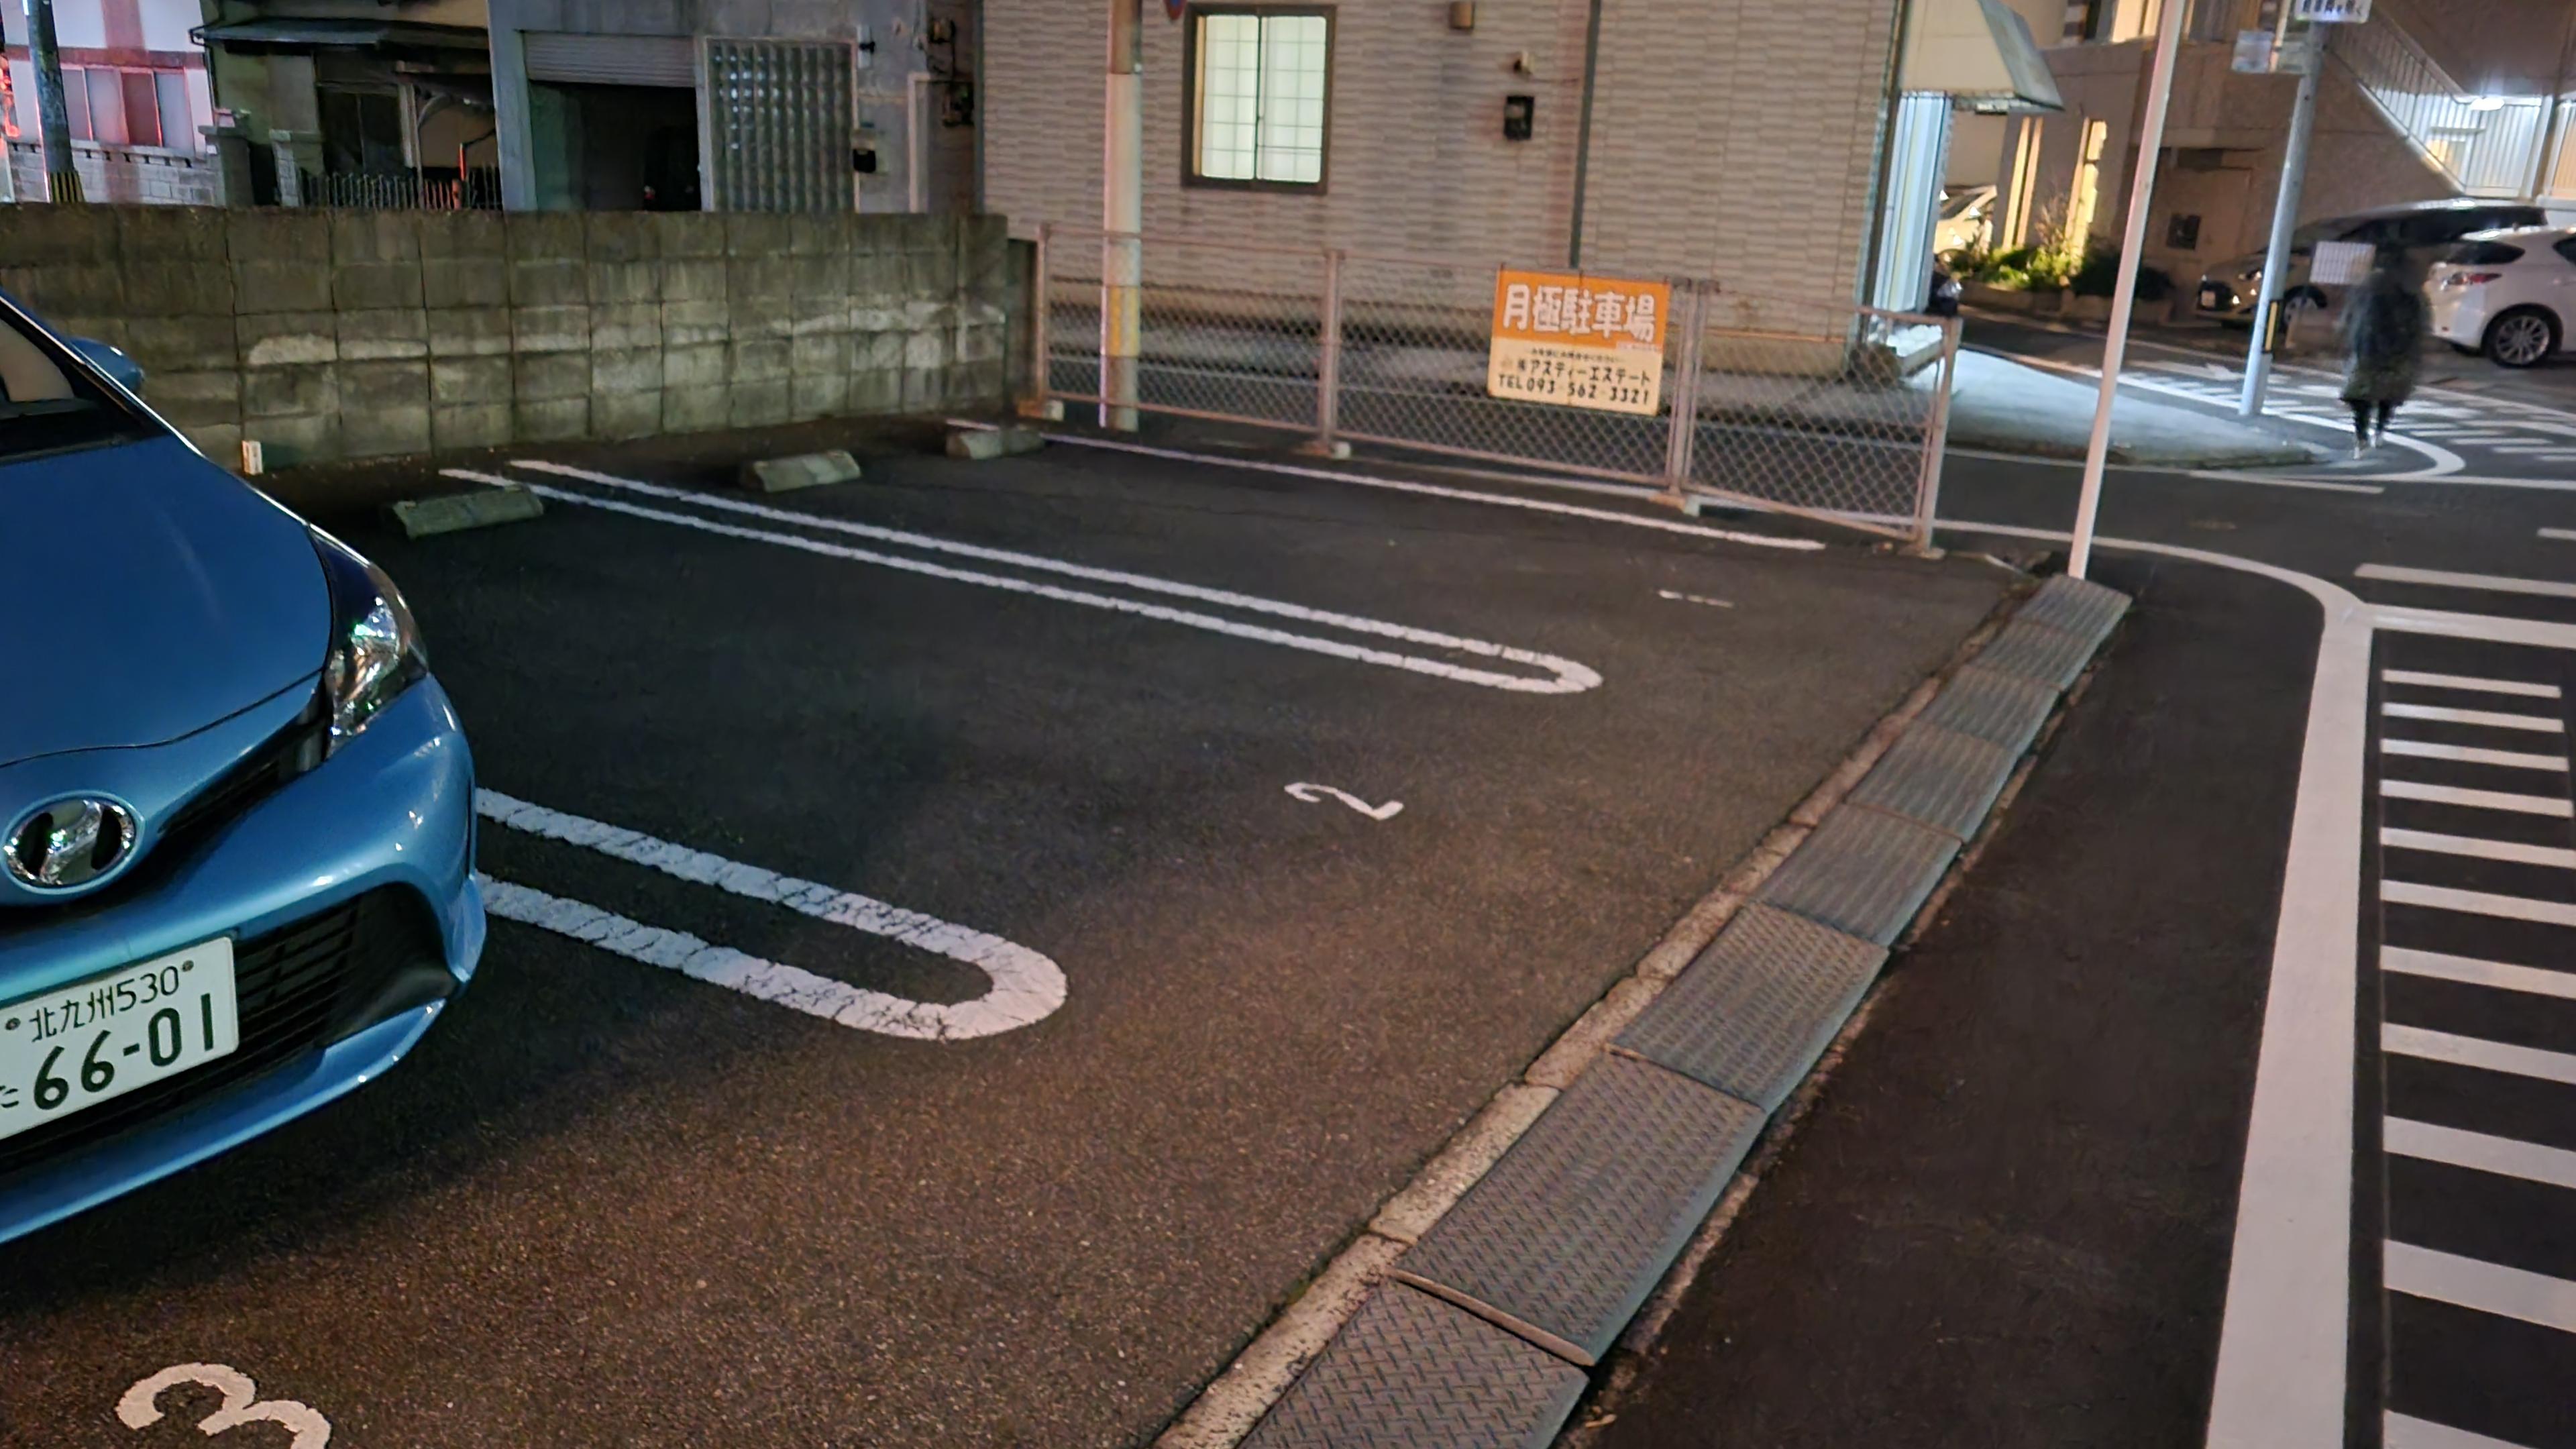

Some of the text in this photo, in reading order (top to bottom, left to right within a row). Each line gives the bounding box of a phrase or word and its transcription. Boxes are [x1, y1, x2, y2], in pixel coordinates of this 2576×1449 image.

[1503, 284, 1656, 343] 月極駐車場
[1284, 782, 1404, 820] 2
[29, 966, 179, 1042] 北九州530
[34, 994, 214, 1110] 66-01
[115, 1362, 331, 1449] 3
